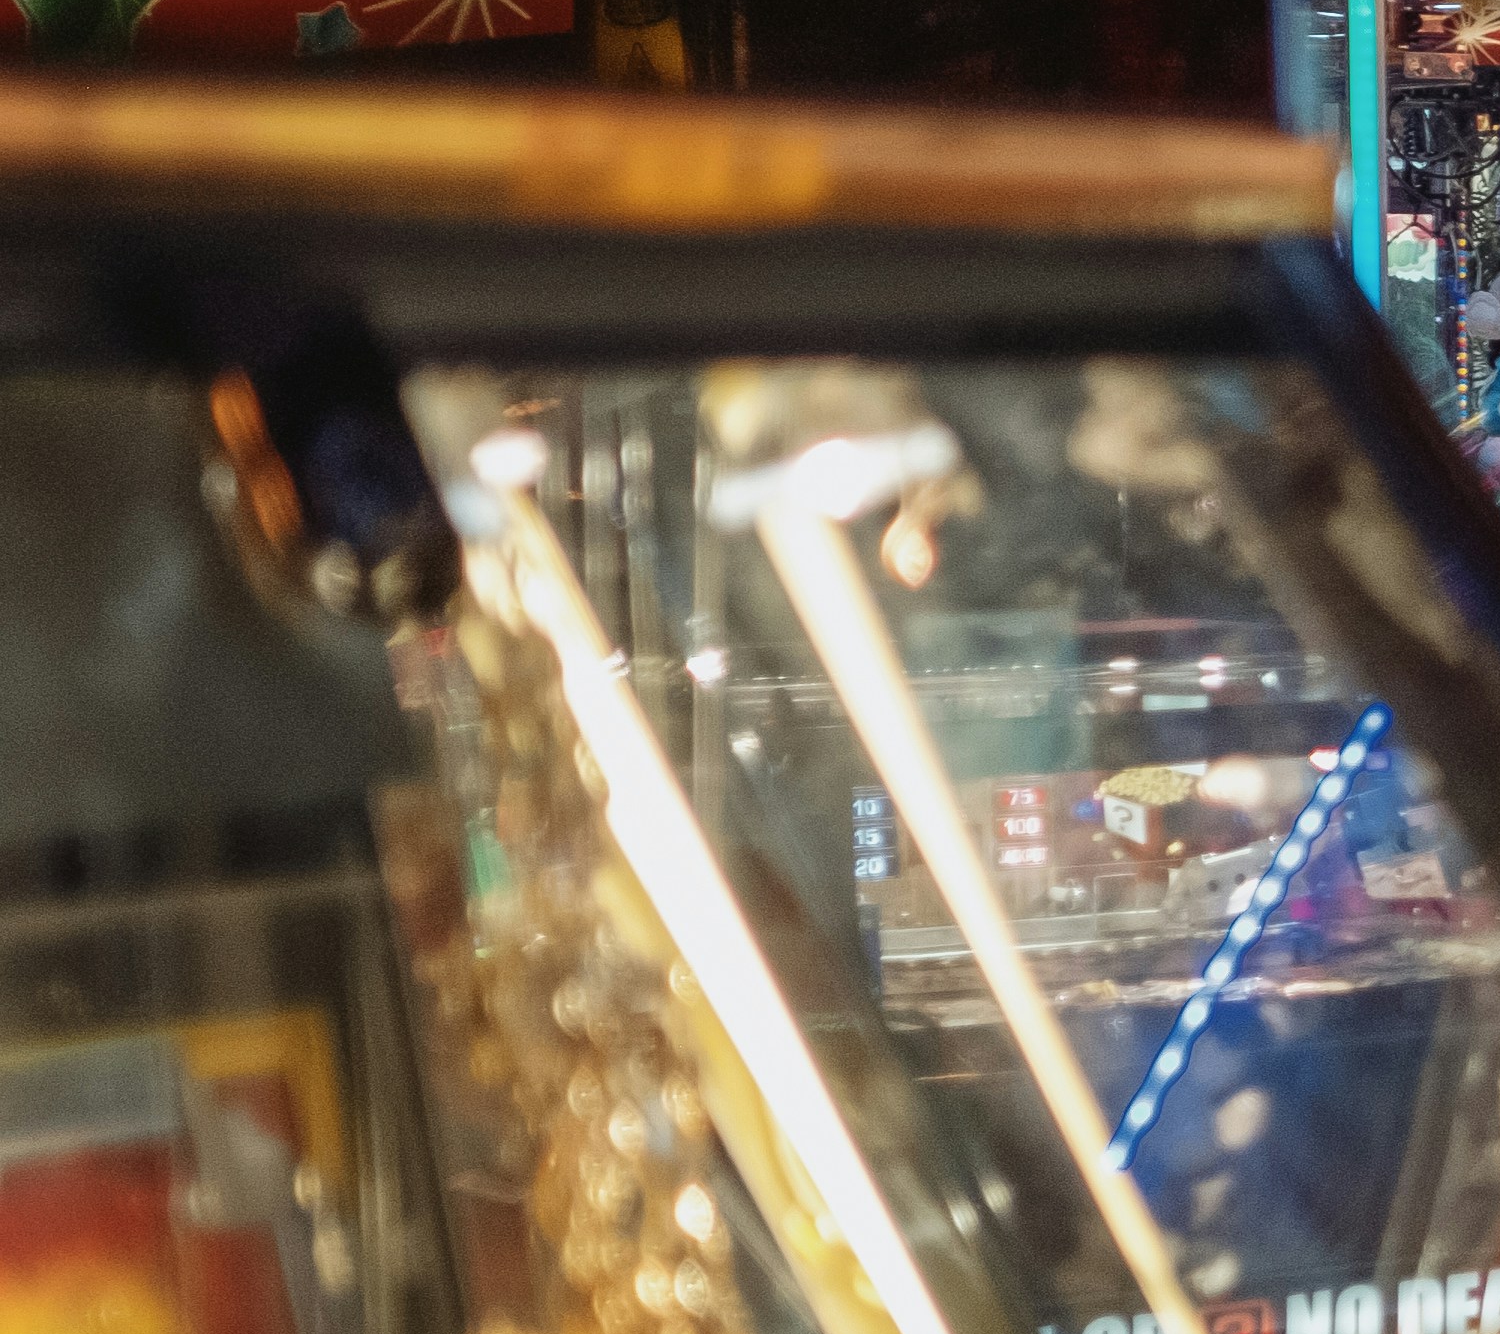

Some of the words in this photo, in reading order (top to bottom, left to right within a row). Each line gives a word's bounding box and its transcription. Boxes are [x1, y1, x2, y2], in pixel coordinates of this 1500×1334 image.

[1008, 789, 1035, 806] 75
[852, 799, 881, 816] 10
[1003, 816, 1044, 836] 100
[853, 828, 881, 845] 15
[854, 857, 886, 877] 20
